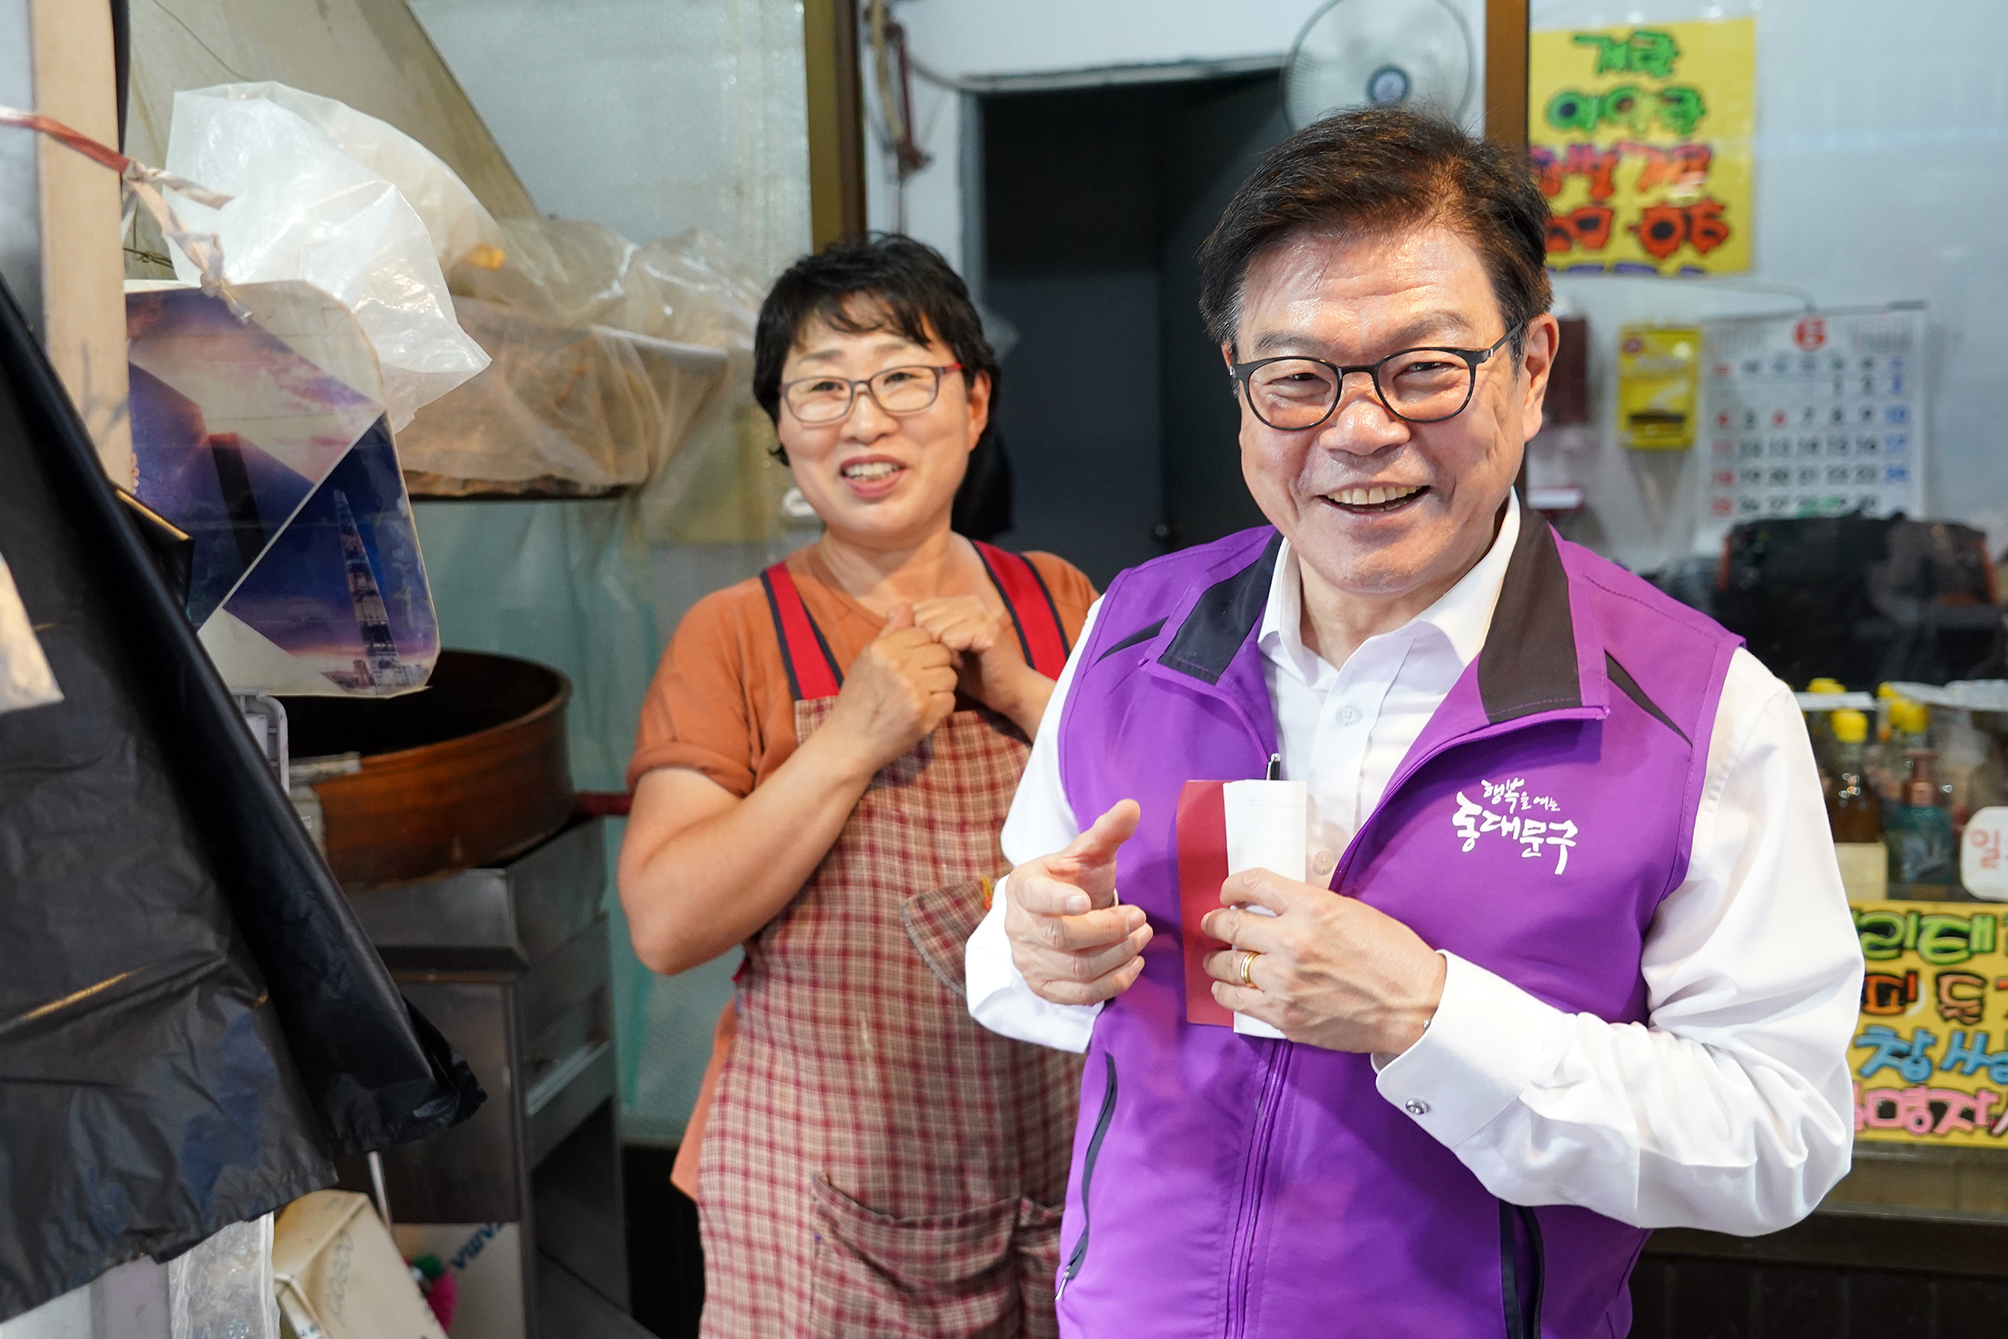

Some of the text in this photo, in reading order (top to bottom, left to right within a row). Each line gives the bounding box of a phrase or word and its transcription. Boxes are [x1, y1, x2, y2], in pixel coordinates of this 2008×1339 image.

[1481, 777, 1560, 814] 행복을 여는
[1452, 791, 1578, 875] 동대문구
[1851, 908, 1996, 966] 리태
